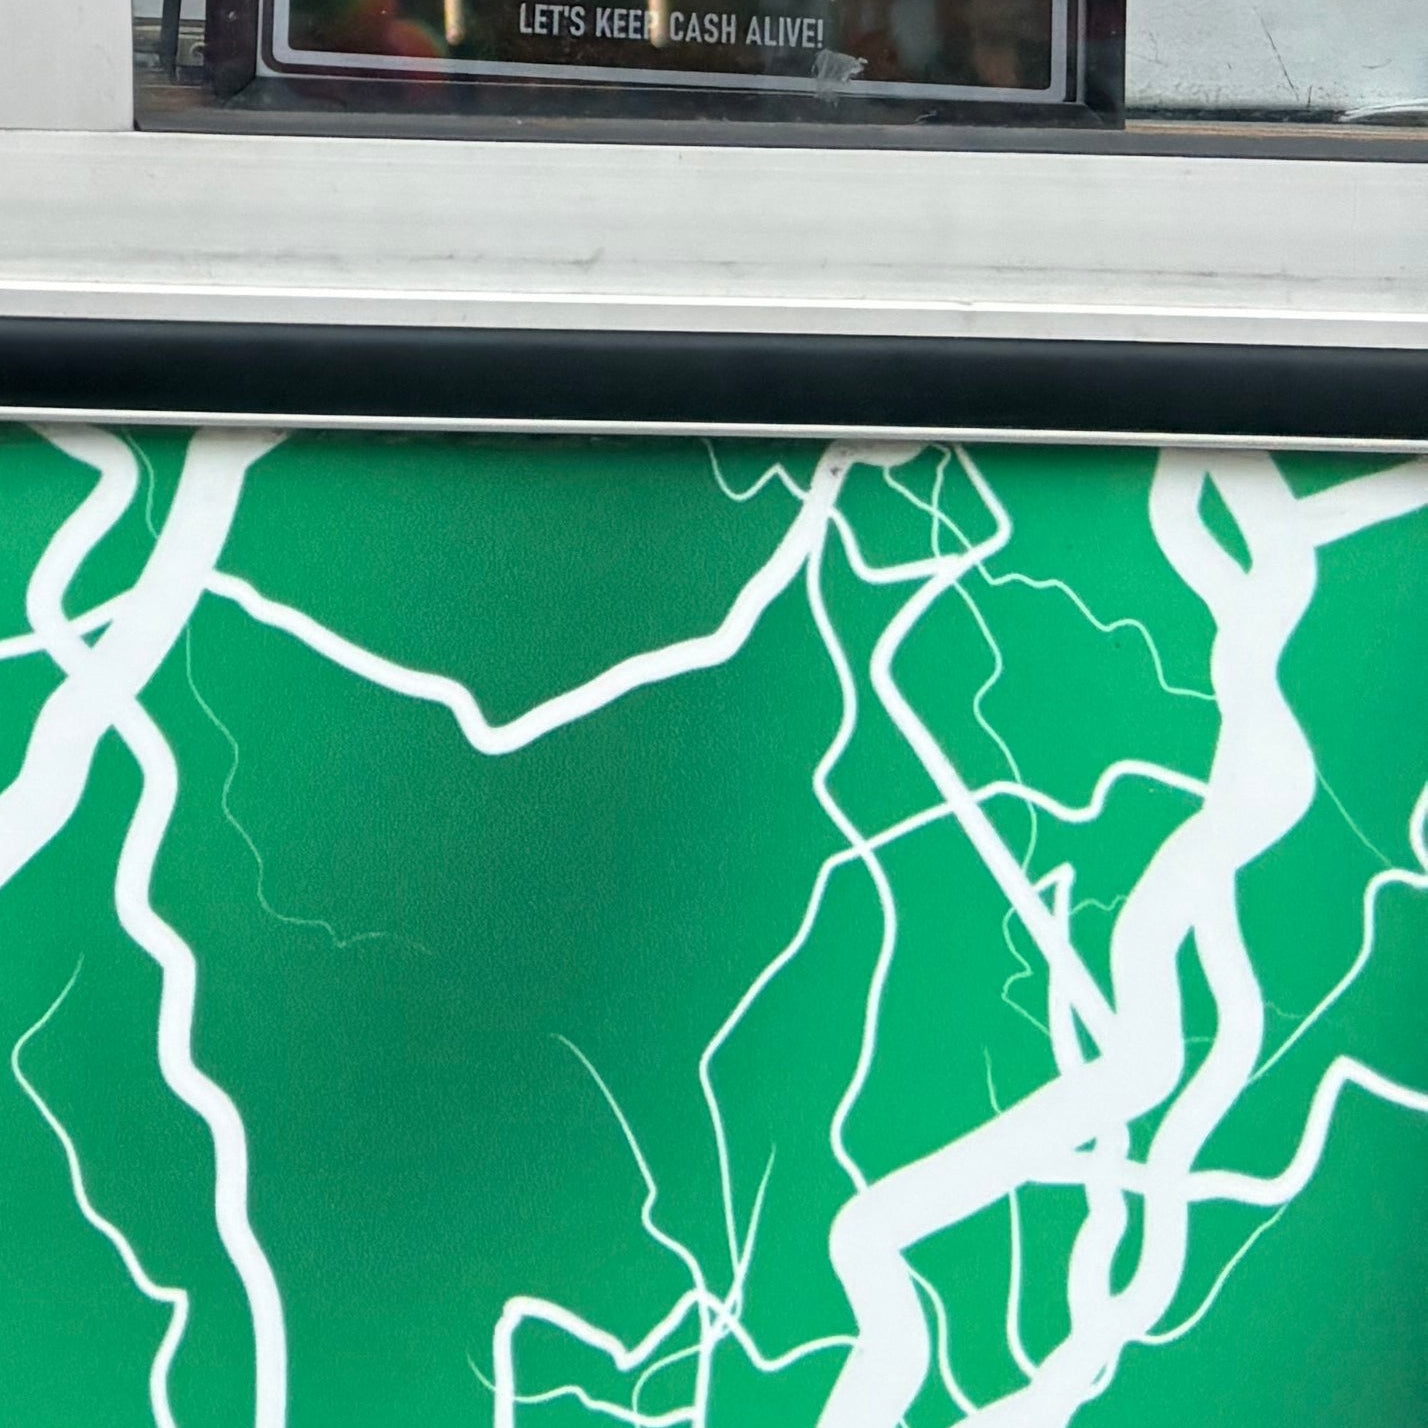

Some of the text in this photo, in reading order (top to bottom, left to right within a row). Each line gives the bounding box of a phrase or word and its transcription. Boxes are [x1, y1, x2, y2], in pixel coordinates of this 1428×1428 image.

[519, 3, 825, 50] LET'S KEEP CASH ALIVE!
